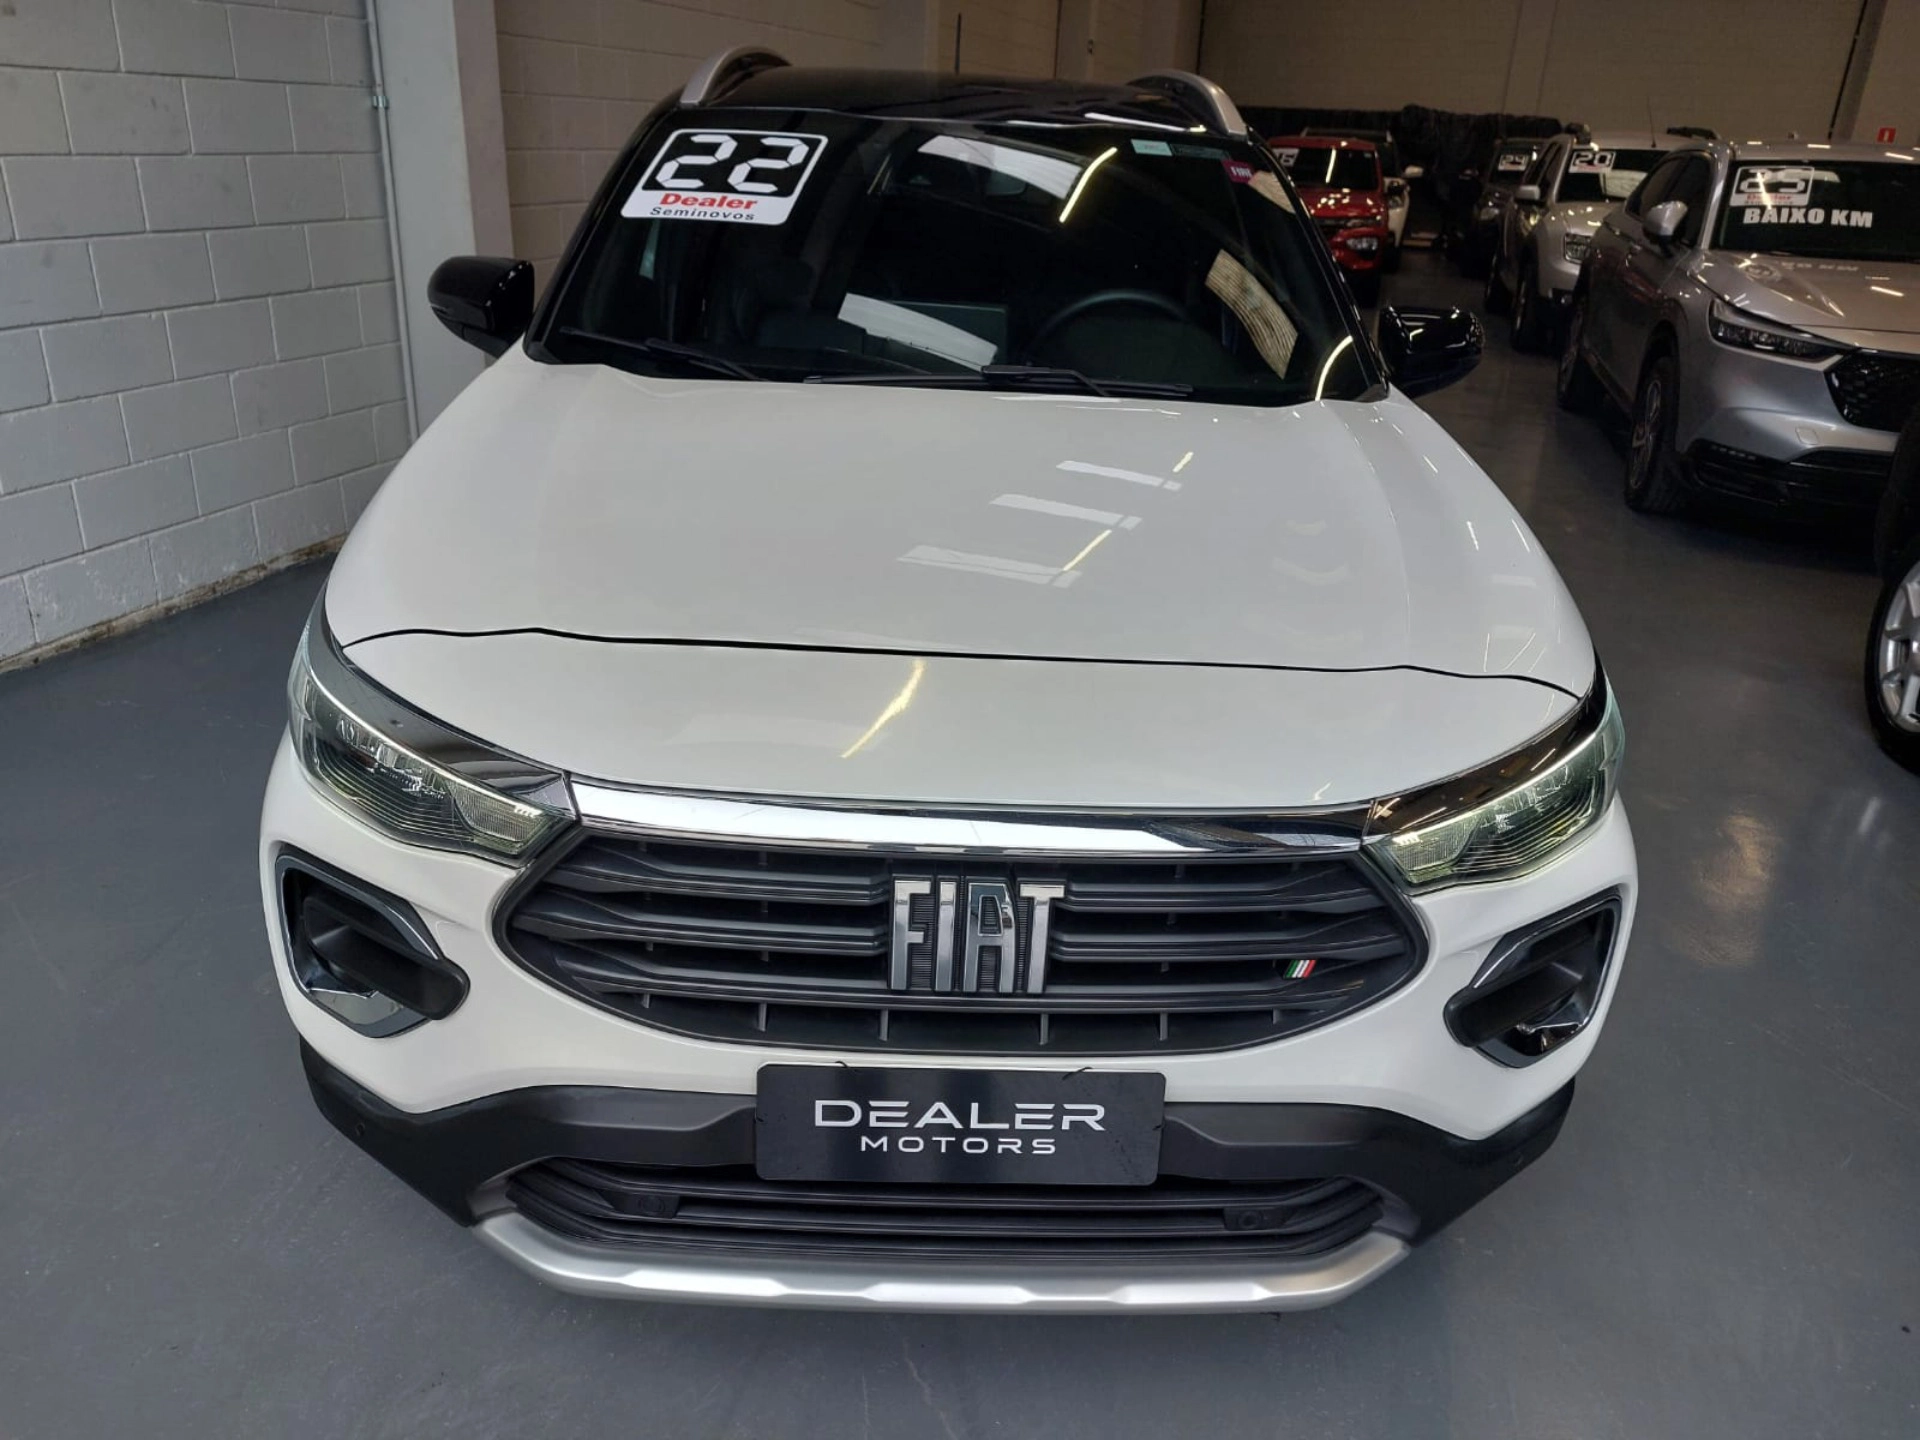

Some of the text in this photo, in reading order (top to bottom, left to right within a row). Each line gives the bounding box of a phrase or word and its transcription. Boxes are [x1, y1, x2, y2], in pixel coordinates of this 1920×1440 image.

[655, 134, 809, 193] 22
[1575, 152, 1611, 167] 20
[660, 193, 757, 209] Dealer
[650, 206, 754, 221] Seminovos
[1743, 206, 1873, 229] BAIXO KM
[890, 880, 1066, 994] FIAT
[815, 1100, 1106, 1131] DEALER
[860, 1135, 1056, 1155] MOTORS
